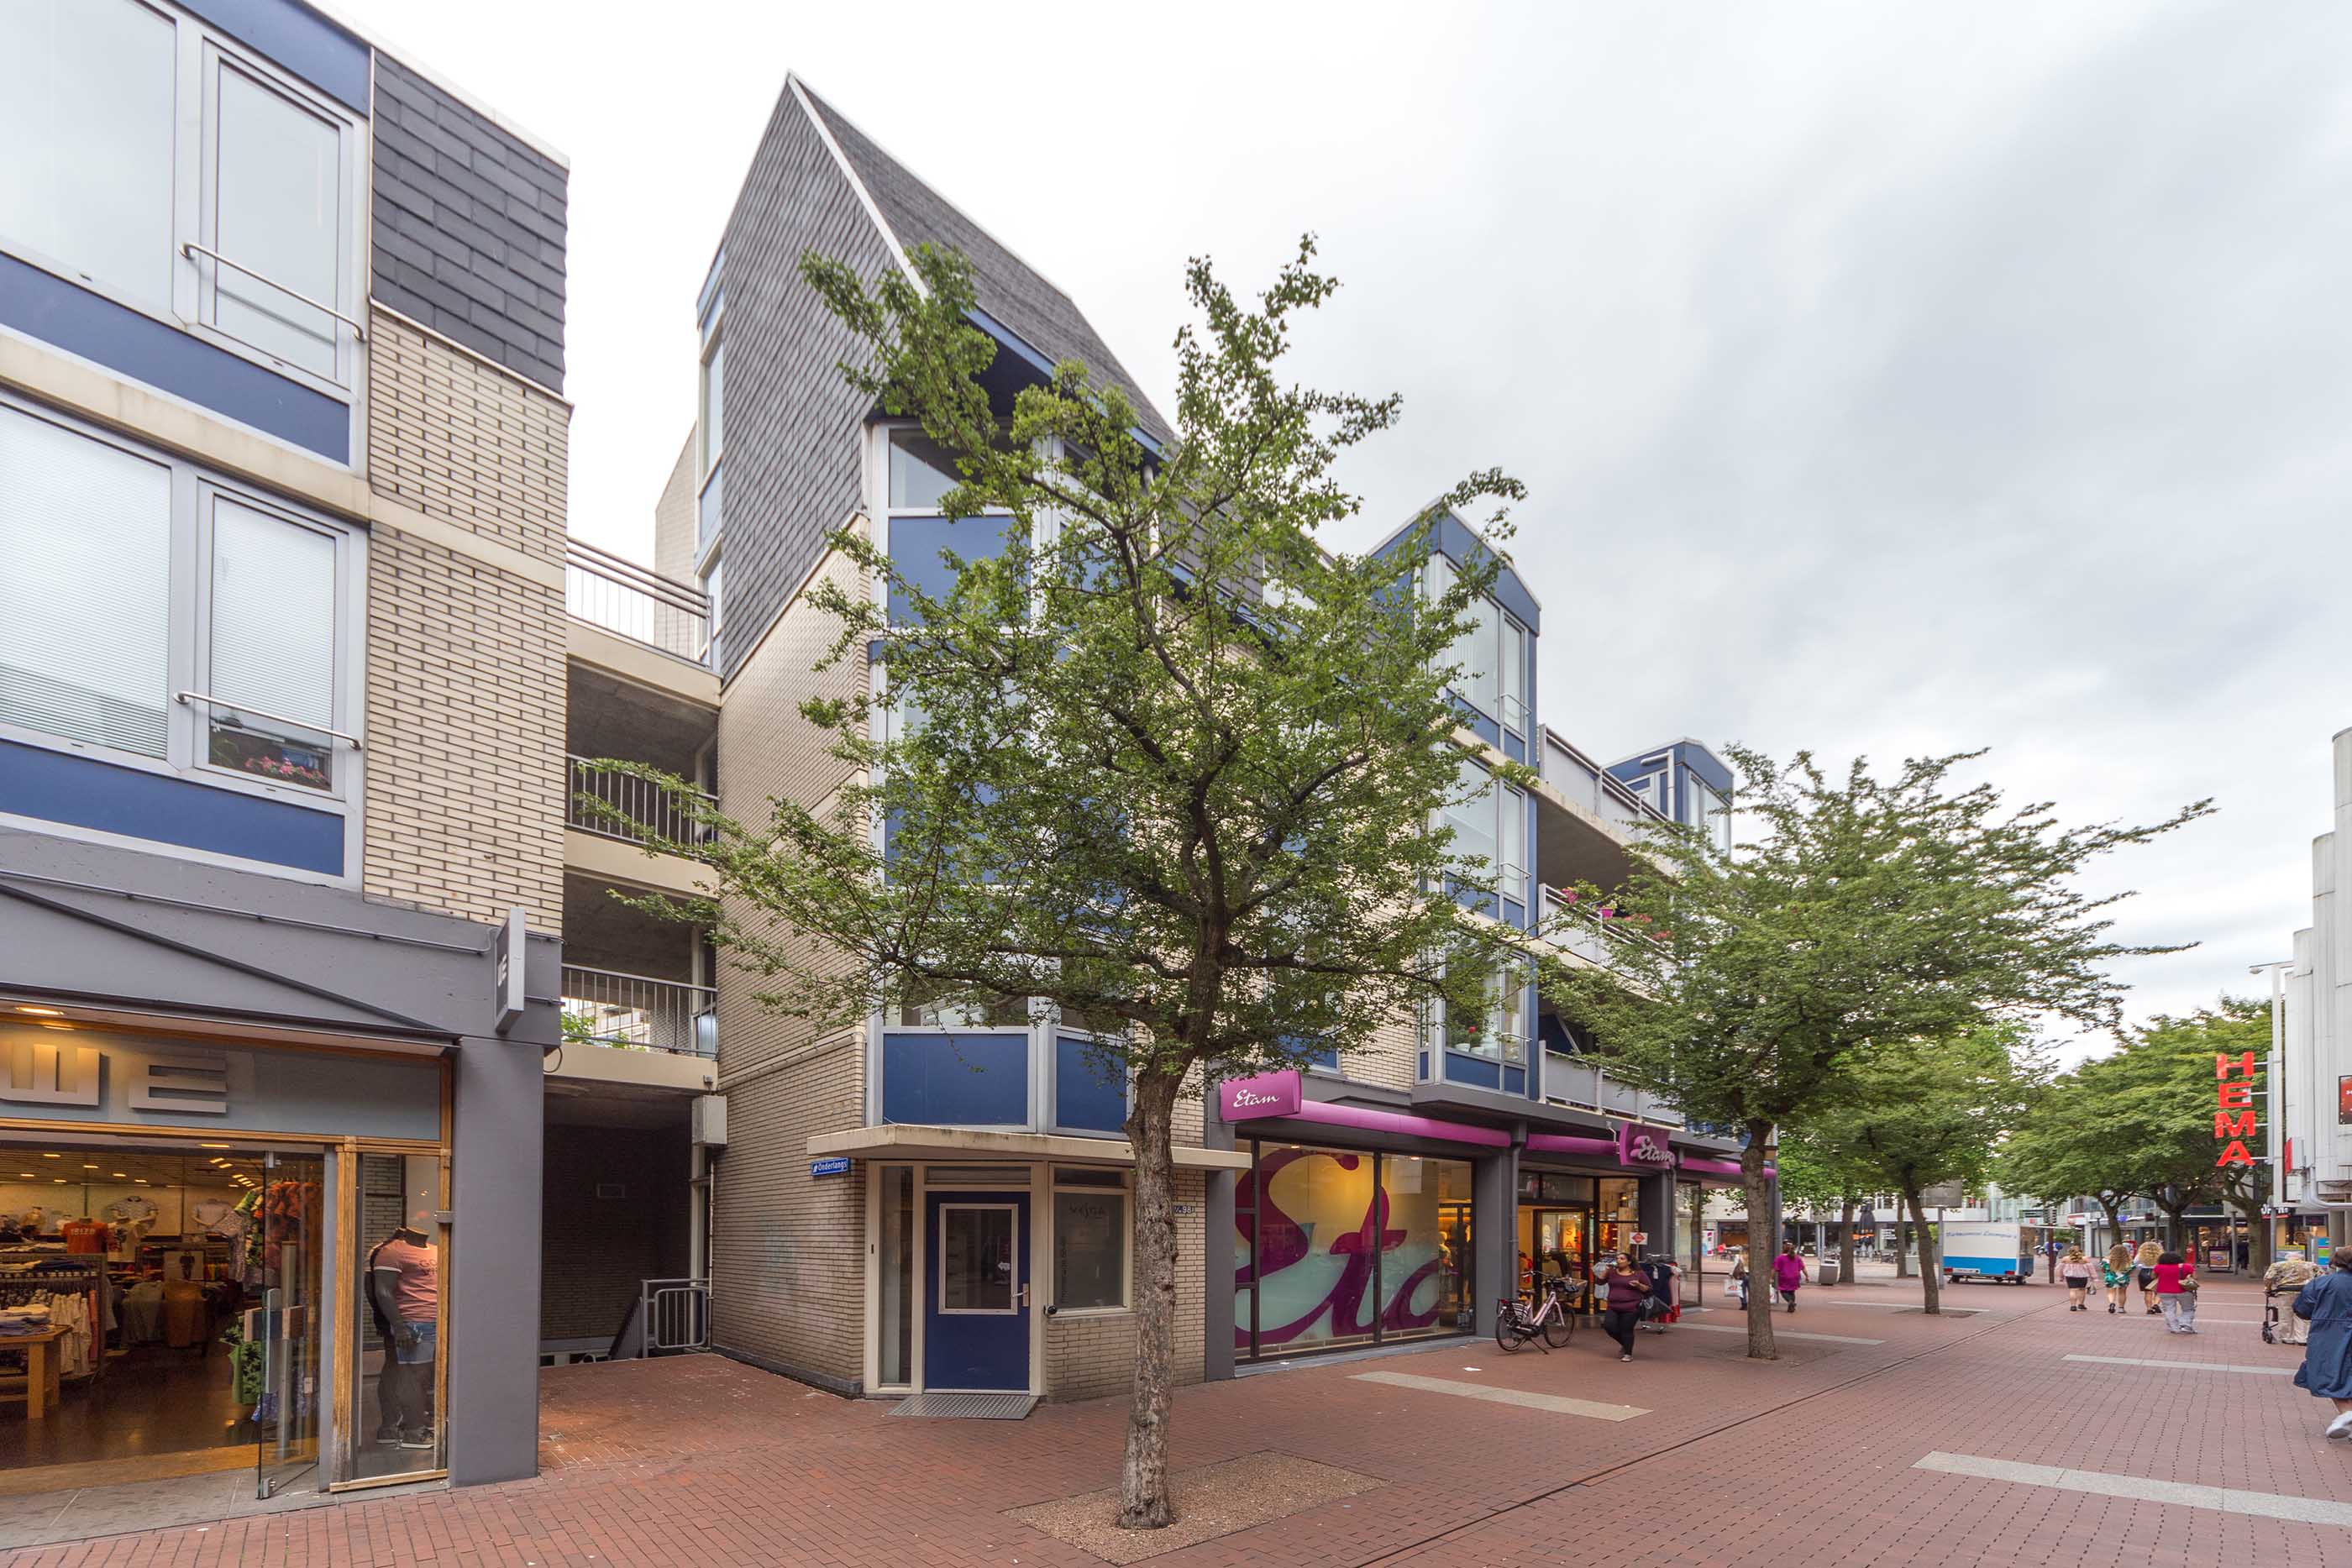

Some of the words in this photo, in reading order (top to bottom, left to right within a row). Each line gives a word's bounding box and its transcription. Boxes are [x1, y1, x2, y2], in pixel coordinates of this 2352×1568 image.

[0, 1041, 228, 1114] WE
[1233, 1089, 1280, 1108] Etam
[2214, 1051, 2256, 1167] HEMA
[1632, 1135, 1675, 1165] Etam
[817, 1161, 847, 1172] Onderlangs
